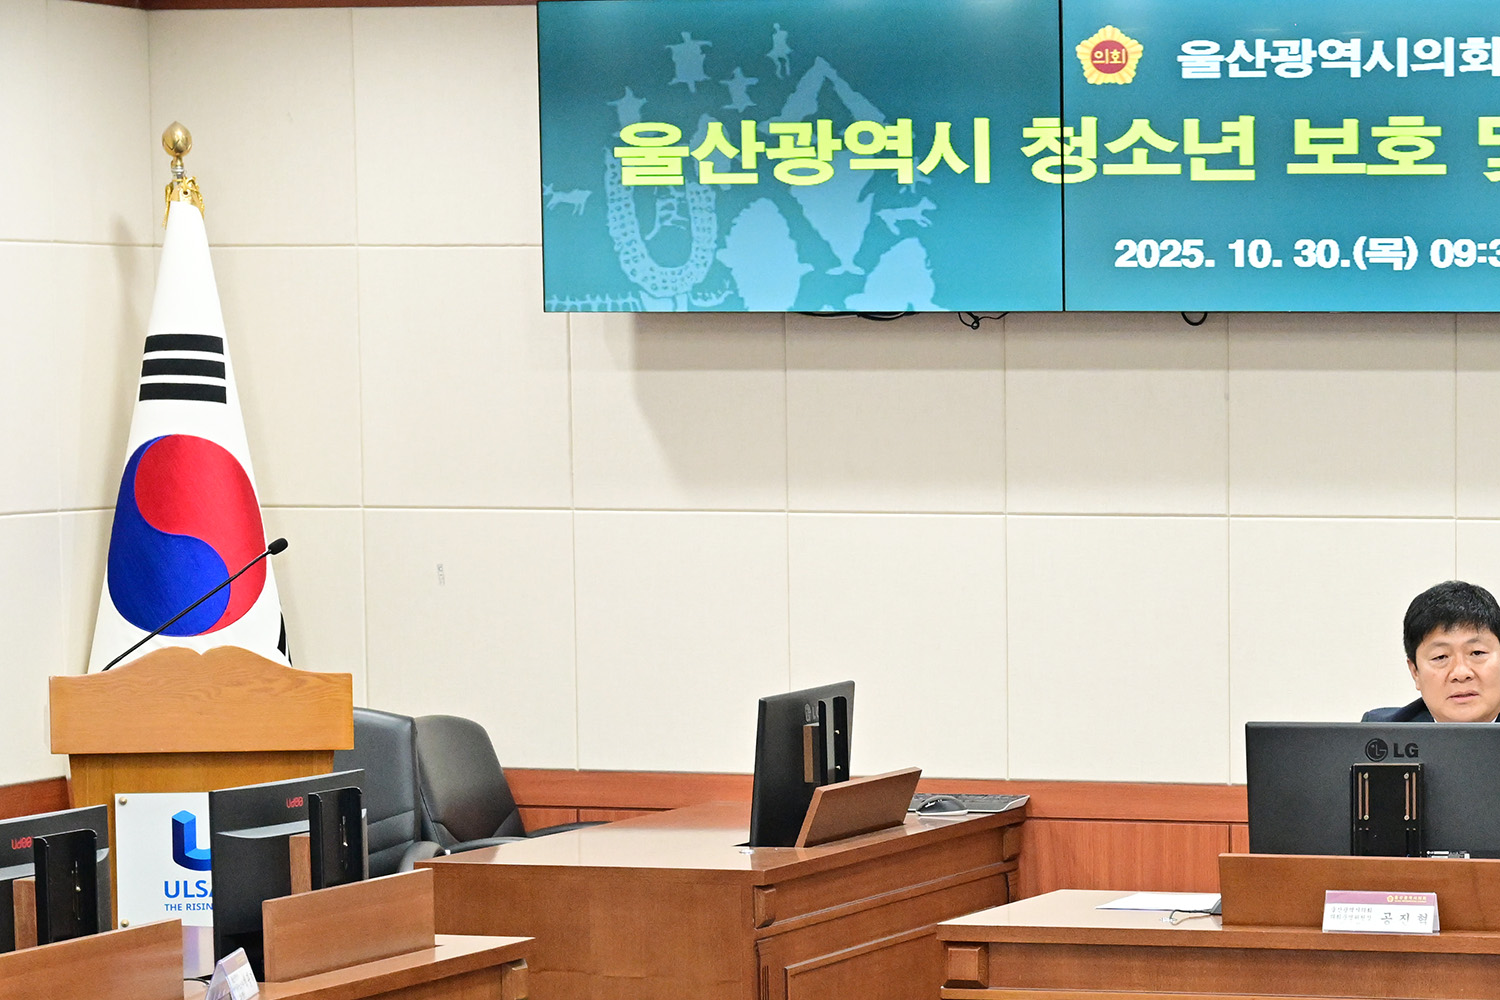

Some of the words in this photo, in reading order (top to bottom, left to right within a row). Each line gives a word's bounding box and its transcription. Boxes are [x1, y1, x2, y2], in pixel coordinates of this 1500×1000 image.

[1092, 48, 1126, 64] 의회
[613, 117, 991, 187] 울산광역시
[1020, 115, 1256, 184] 청소년
[1286, 115, 1447, 175] 보호
[1114, 239, 1216, 269] 2025.
[1228, 239, 1284, 269] 10.
[1293, 236, 1419, 271] 30.(목)
[1393, 742, 1419, 758] LG
[164, 880, 213, 899] ULS
[164, 903, 183, 911] THE
